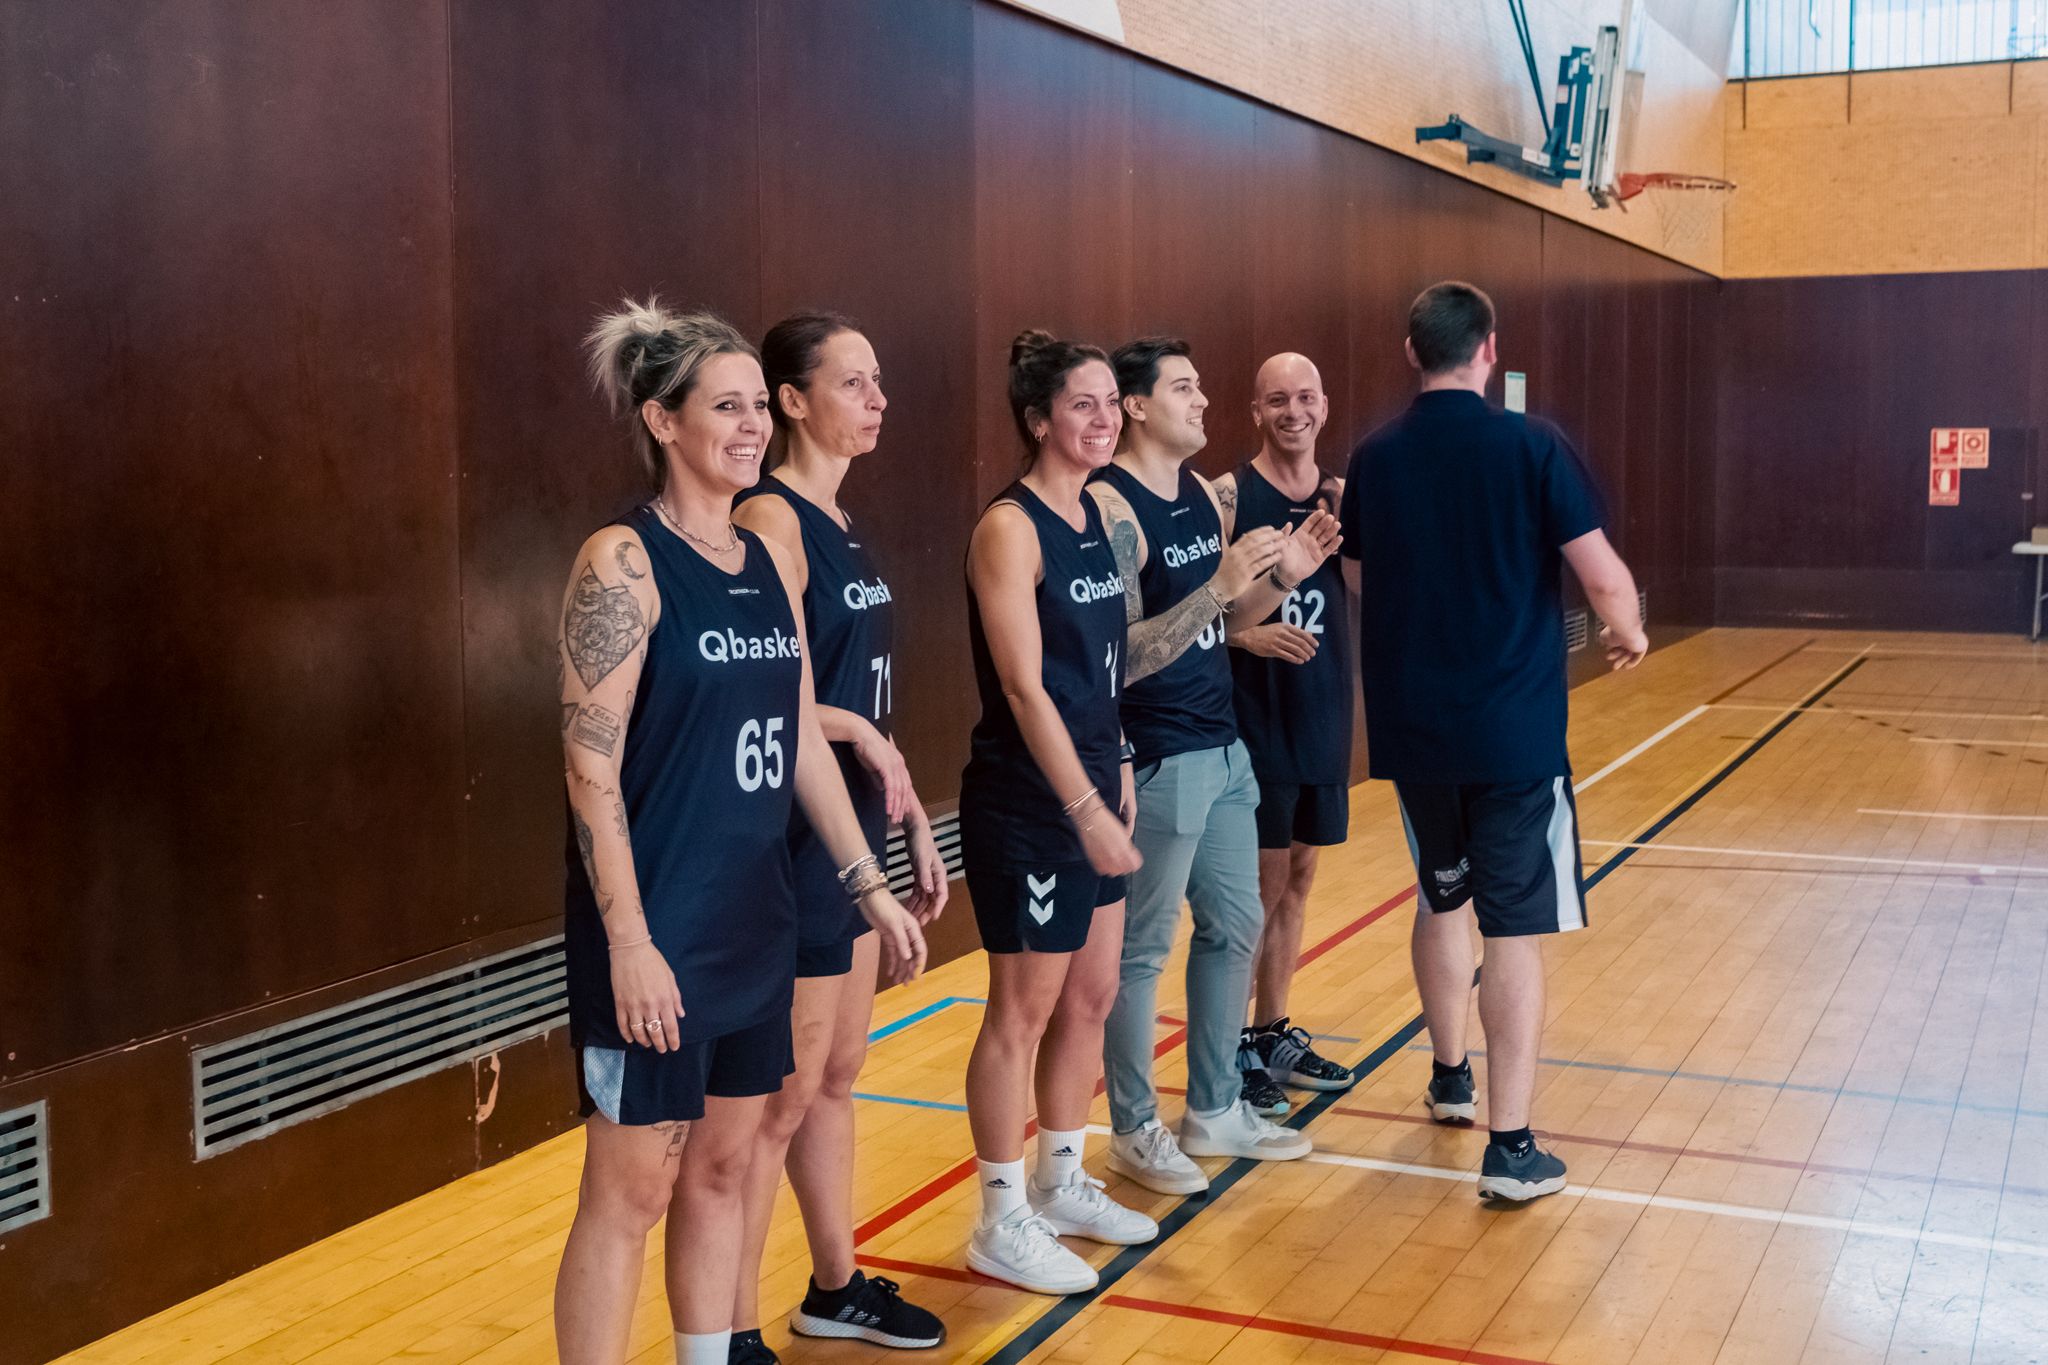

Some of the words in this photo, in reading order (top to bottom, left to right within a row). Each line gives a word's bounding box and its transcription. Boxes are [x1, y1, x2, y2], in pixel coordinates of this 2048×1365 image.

[1163, 534, 1221, 568] Qbasket
[843, 576, 892, 610] Qbask
[1070, 572, 1124, 604] Qbask
[1281, 589, 1325, 634] 62
[698, 627, 801, 663] Qbaske
[871, 652, 891, 720] 71
[735, 716, 784, 792] 65
